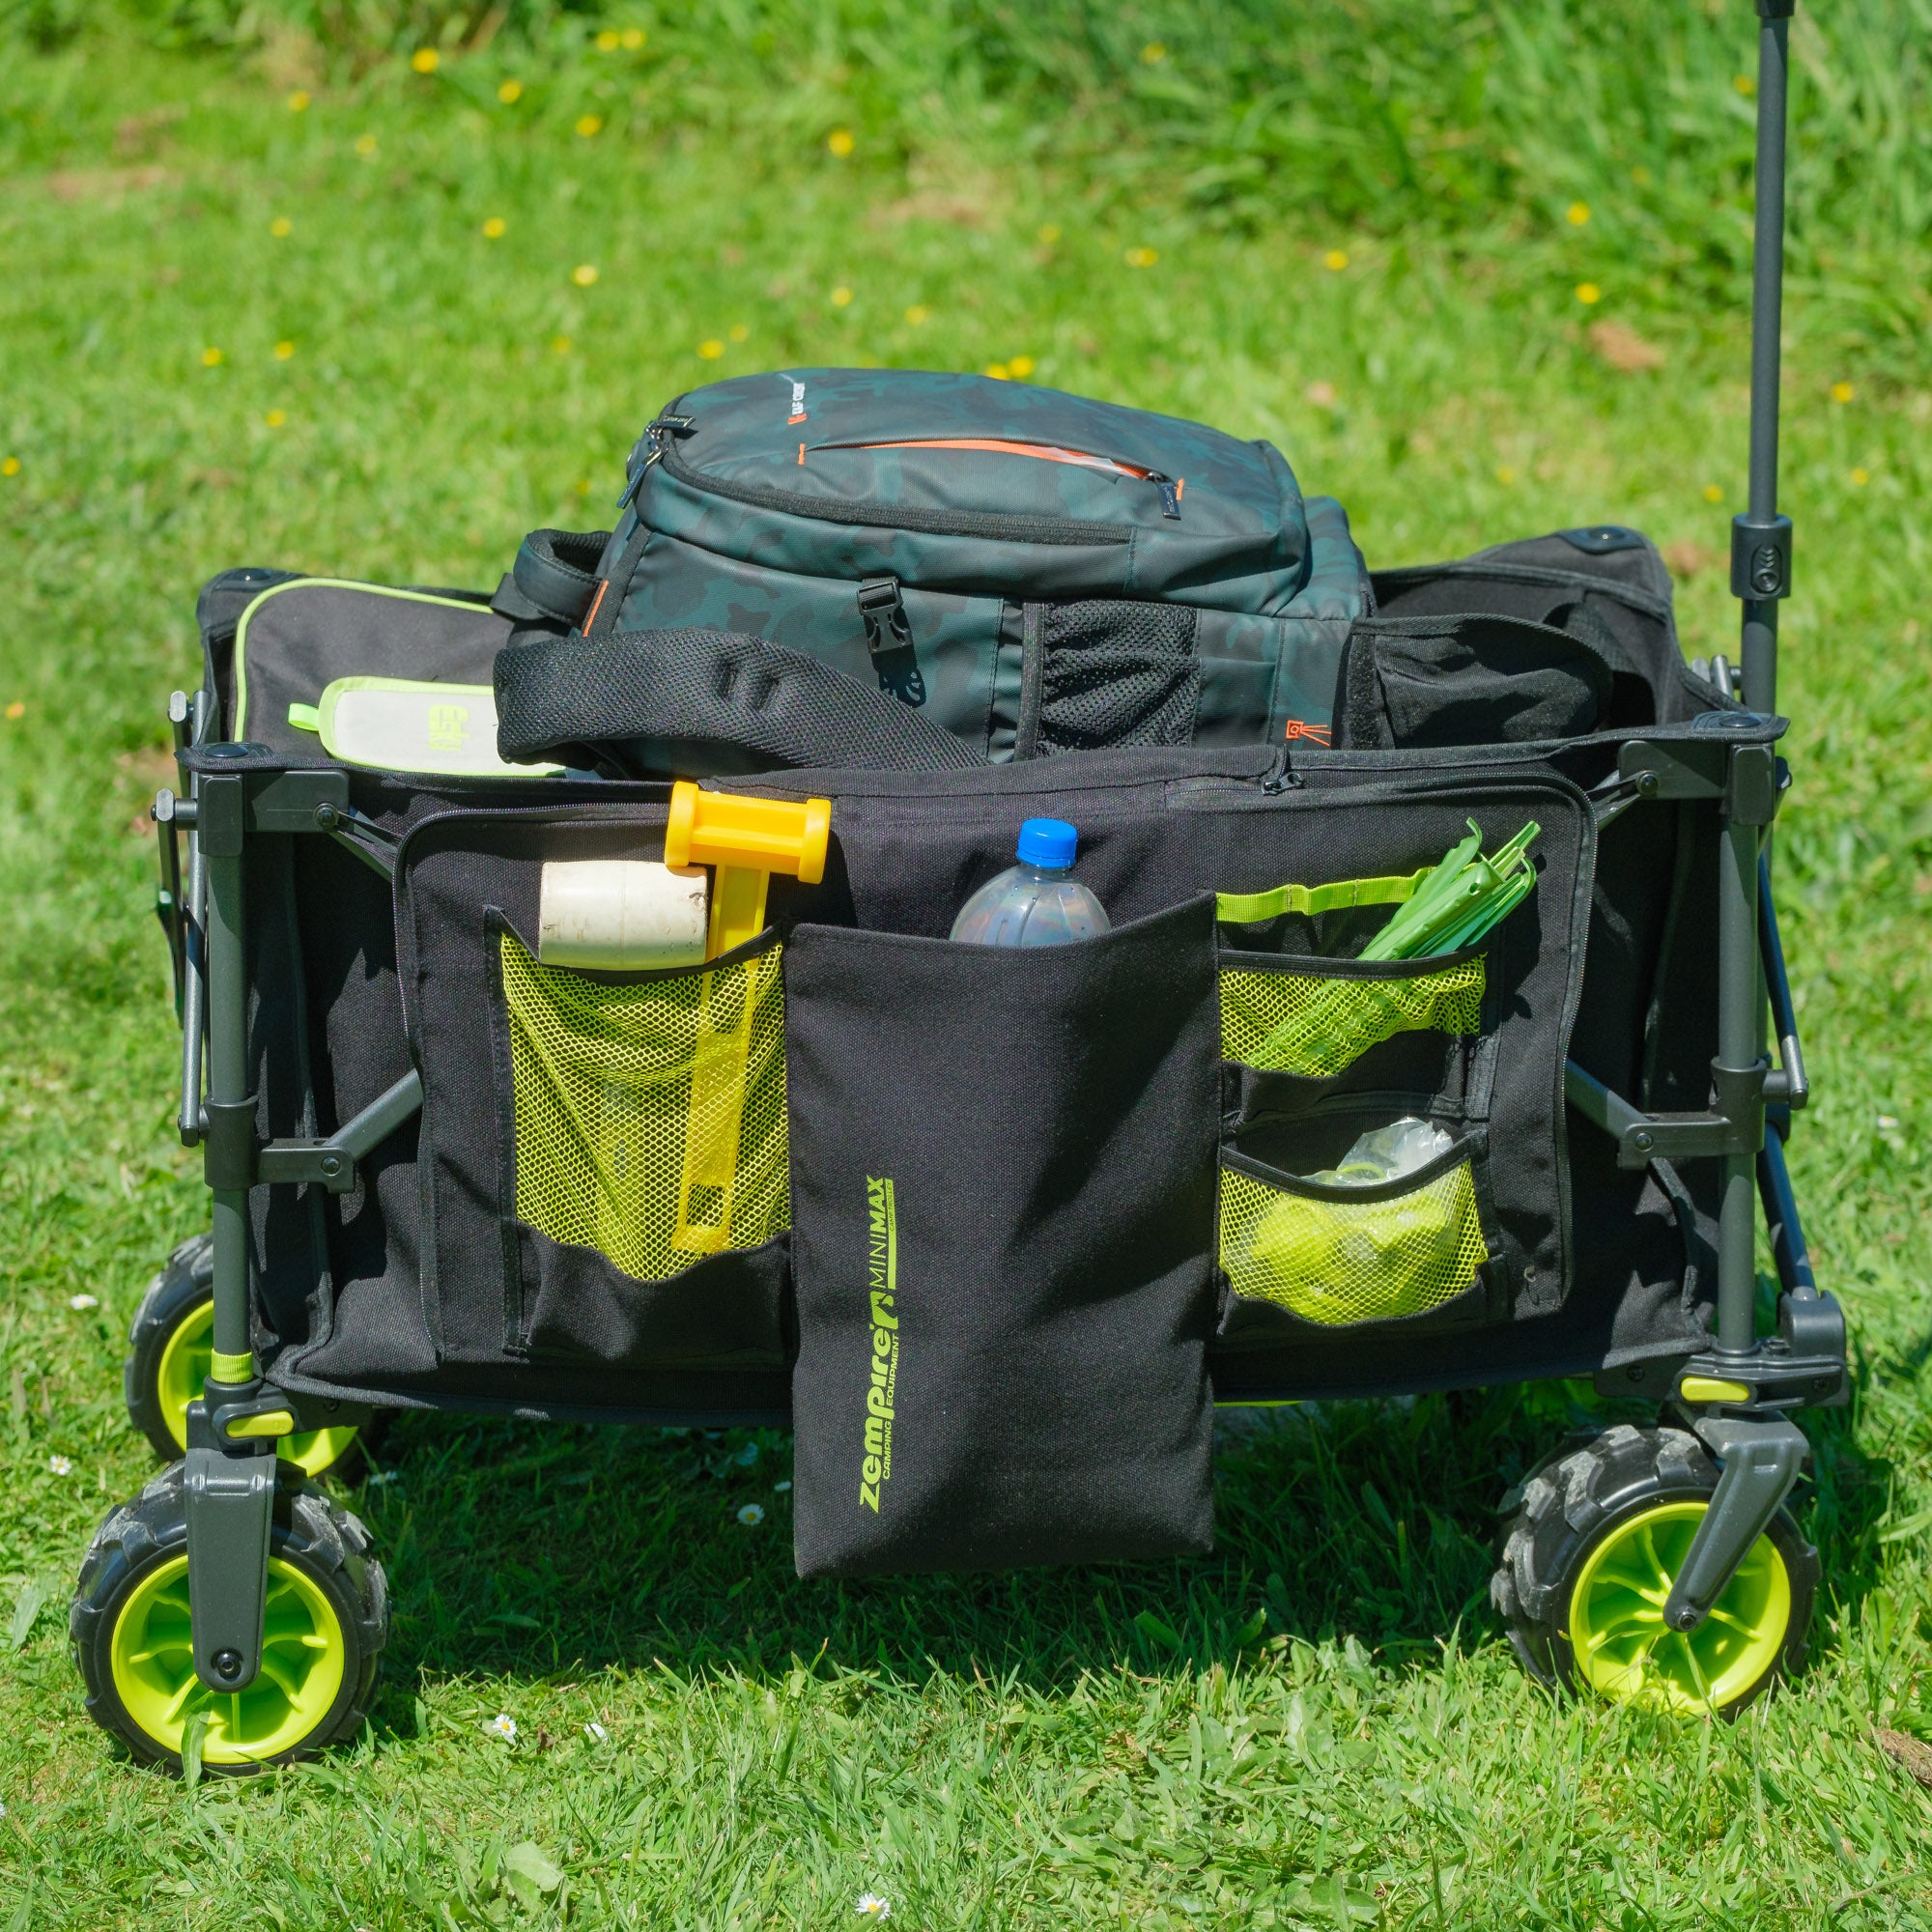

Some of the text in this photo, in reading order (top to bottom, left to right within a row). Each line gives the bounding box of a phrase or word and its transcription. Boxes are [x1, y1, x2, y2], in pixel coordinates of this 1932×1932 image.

[867, 1175, 887, 1289] MINIMAX
[883, 1334, 899, 1480] CAMPING EQUIPMENT
